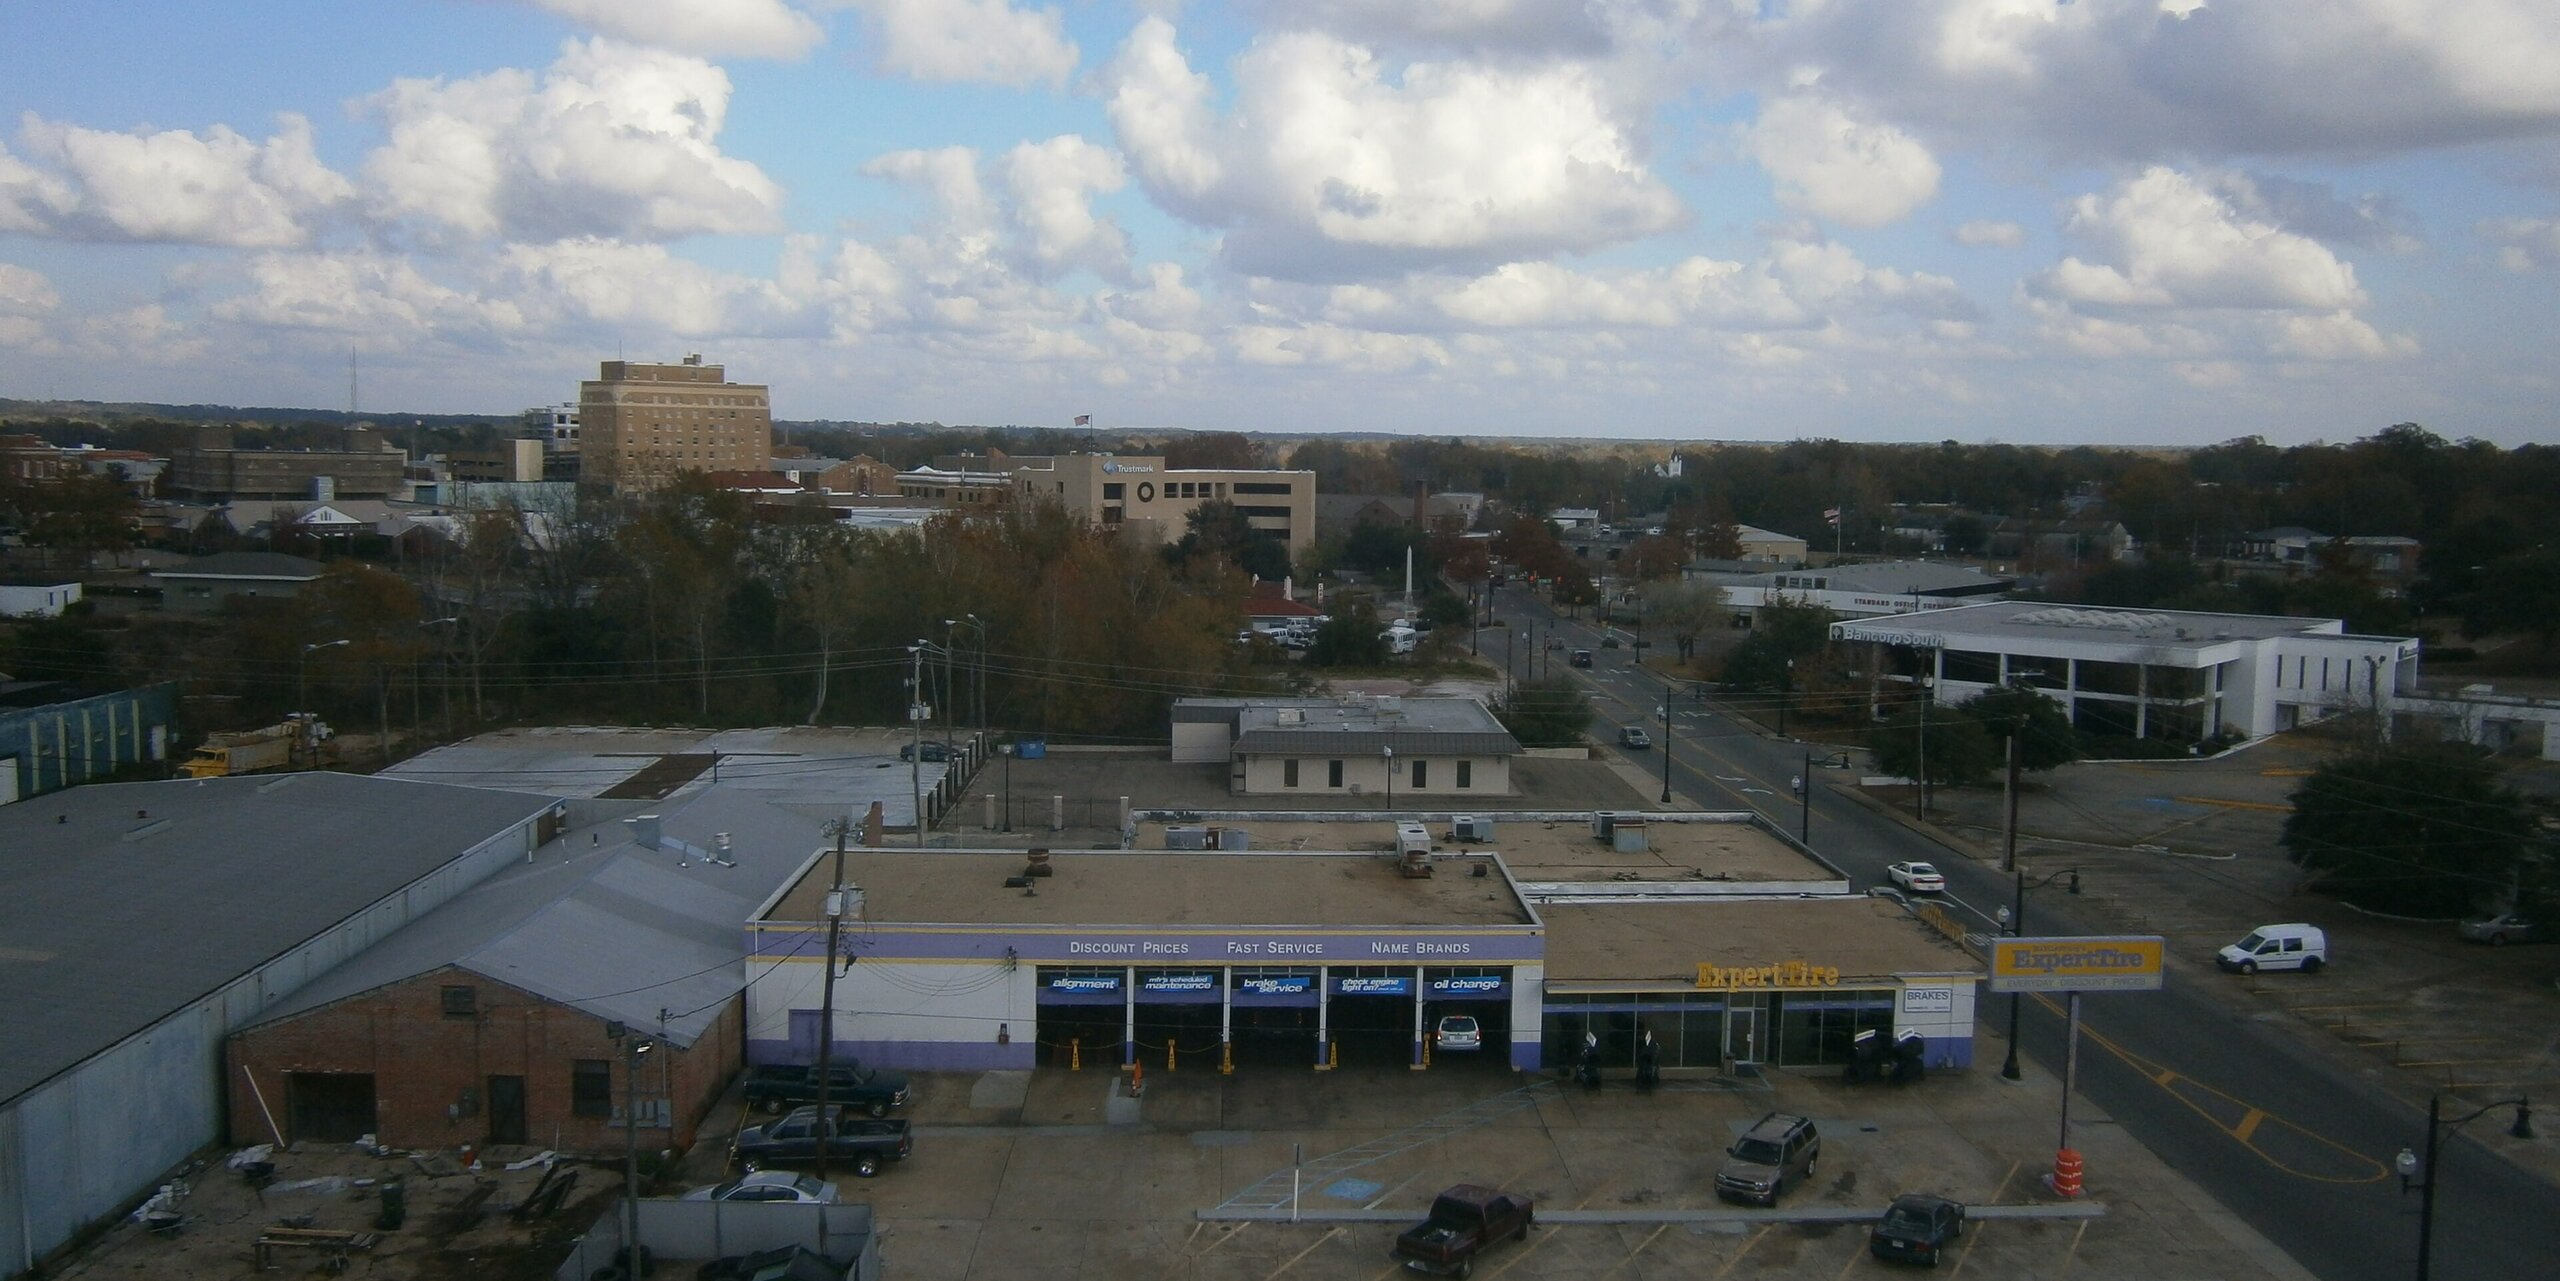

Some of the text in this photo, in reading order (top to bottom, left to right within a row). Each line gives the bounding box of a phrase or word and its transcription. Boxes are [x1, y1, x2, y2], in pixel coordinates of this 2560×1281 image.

[1117, 463, 1154, 473] Trustmark
[1854, 598, 1890, 607] STANDARD
[1893, 600, 1919, 609] OFFIC
[1843, 627, 1944, 648] BancorpSouth
[1069, 941, 1471, 955] DISCOUNT PRICES FAST SERVICE NAME BRANDS
[1695, 959, 1841, 991] ExpertTire
[1052, 977, 1116, 991] alignment
[1145, 982, 1212, 990] maintenance
[1243, 978, 1279, 988] brake
[1341, 978, 1400, 987] check engine
[1433, 977, 1500, 990] oil change
[1258, 983, 1304, 993] service
[1341, 984, 1362, 992] light
[1906, 991, 1950, 1001] BRAKES
